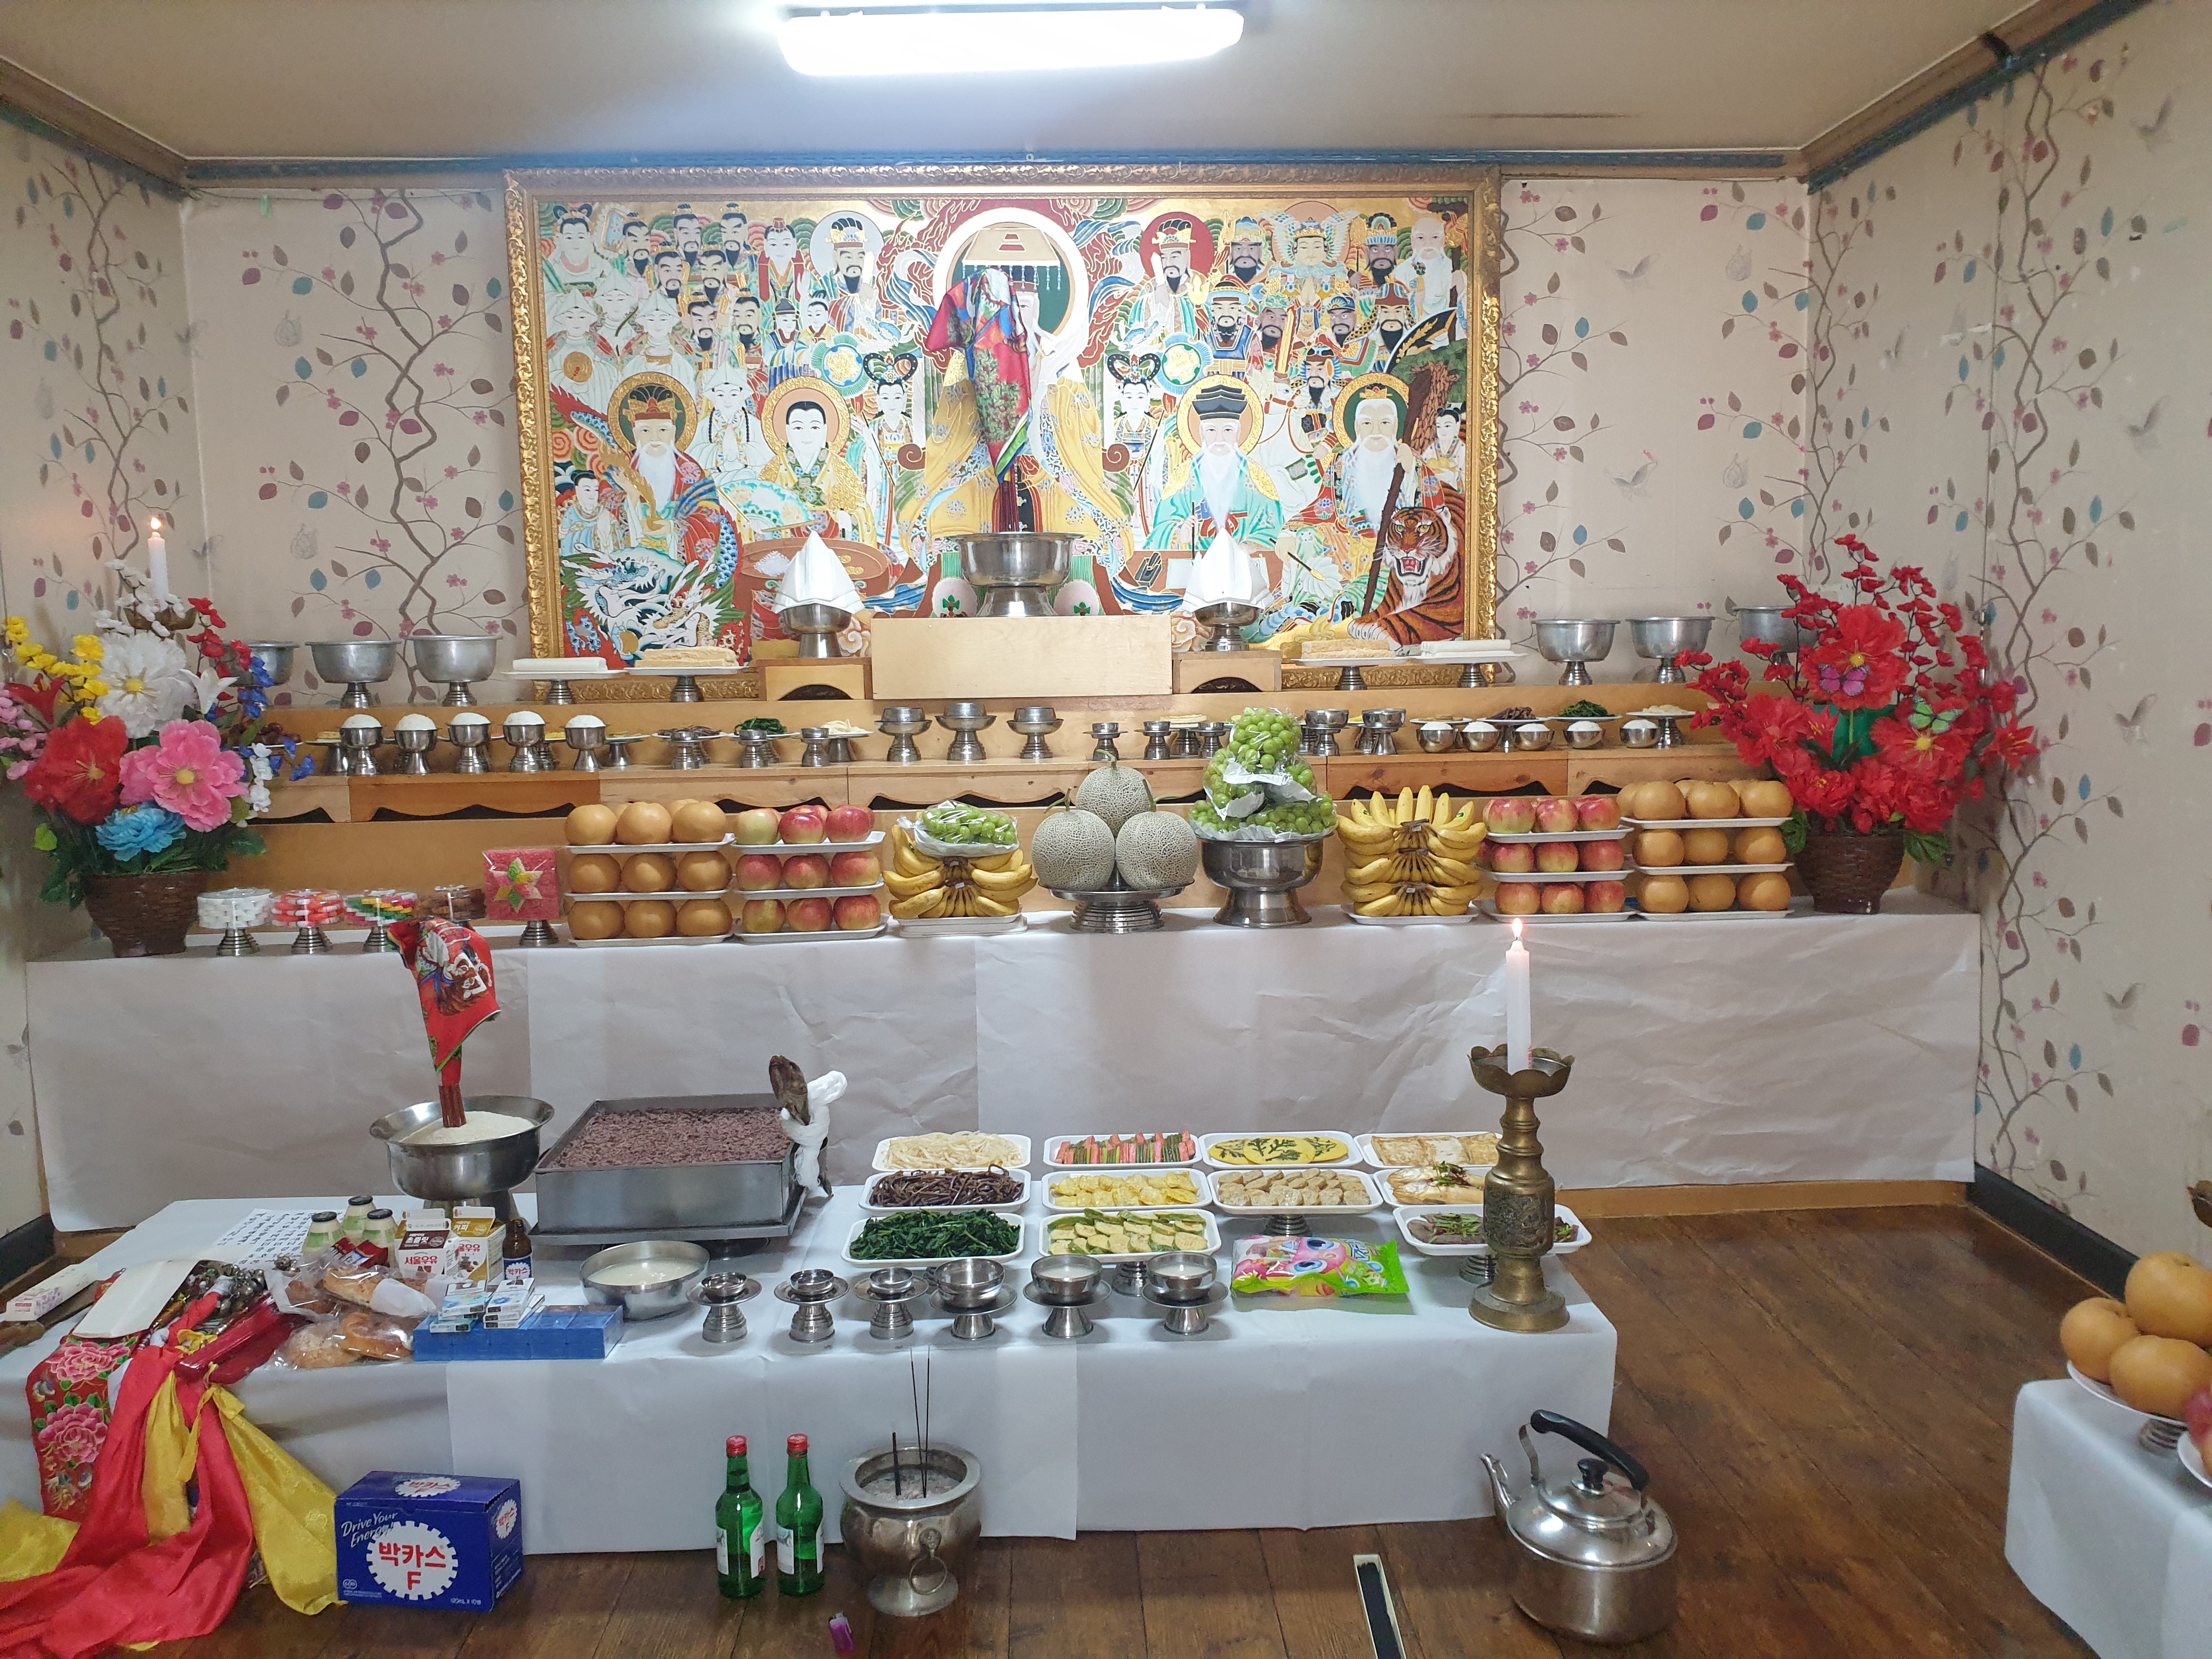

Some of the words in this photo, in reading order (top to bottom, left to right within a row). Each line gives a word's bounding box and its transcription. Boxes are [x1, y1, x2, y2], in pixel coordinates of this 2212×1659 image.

[459, 1243, 481, 1252] 울우유
[404, 1256, 438, 1265] 서울우유
[508, 1267, 528, 1276] 박카스
[409, 1481, 450, 1489] 박카스
[499, 1506, 515, 1527] 박카스
[341, 1519, 372, 1537] Drive
[373, 1511, 398, 1525] Your
[505, 1522, 510, 1532] F
[351, 1521, 394, 1548] Energy!
[379, 1542, 447, 1568] 박카스
[407, 1571, 422, 1590] F
